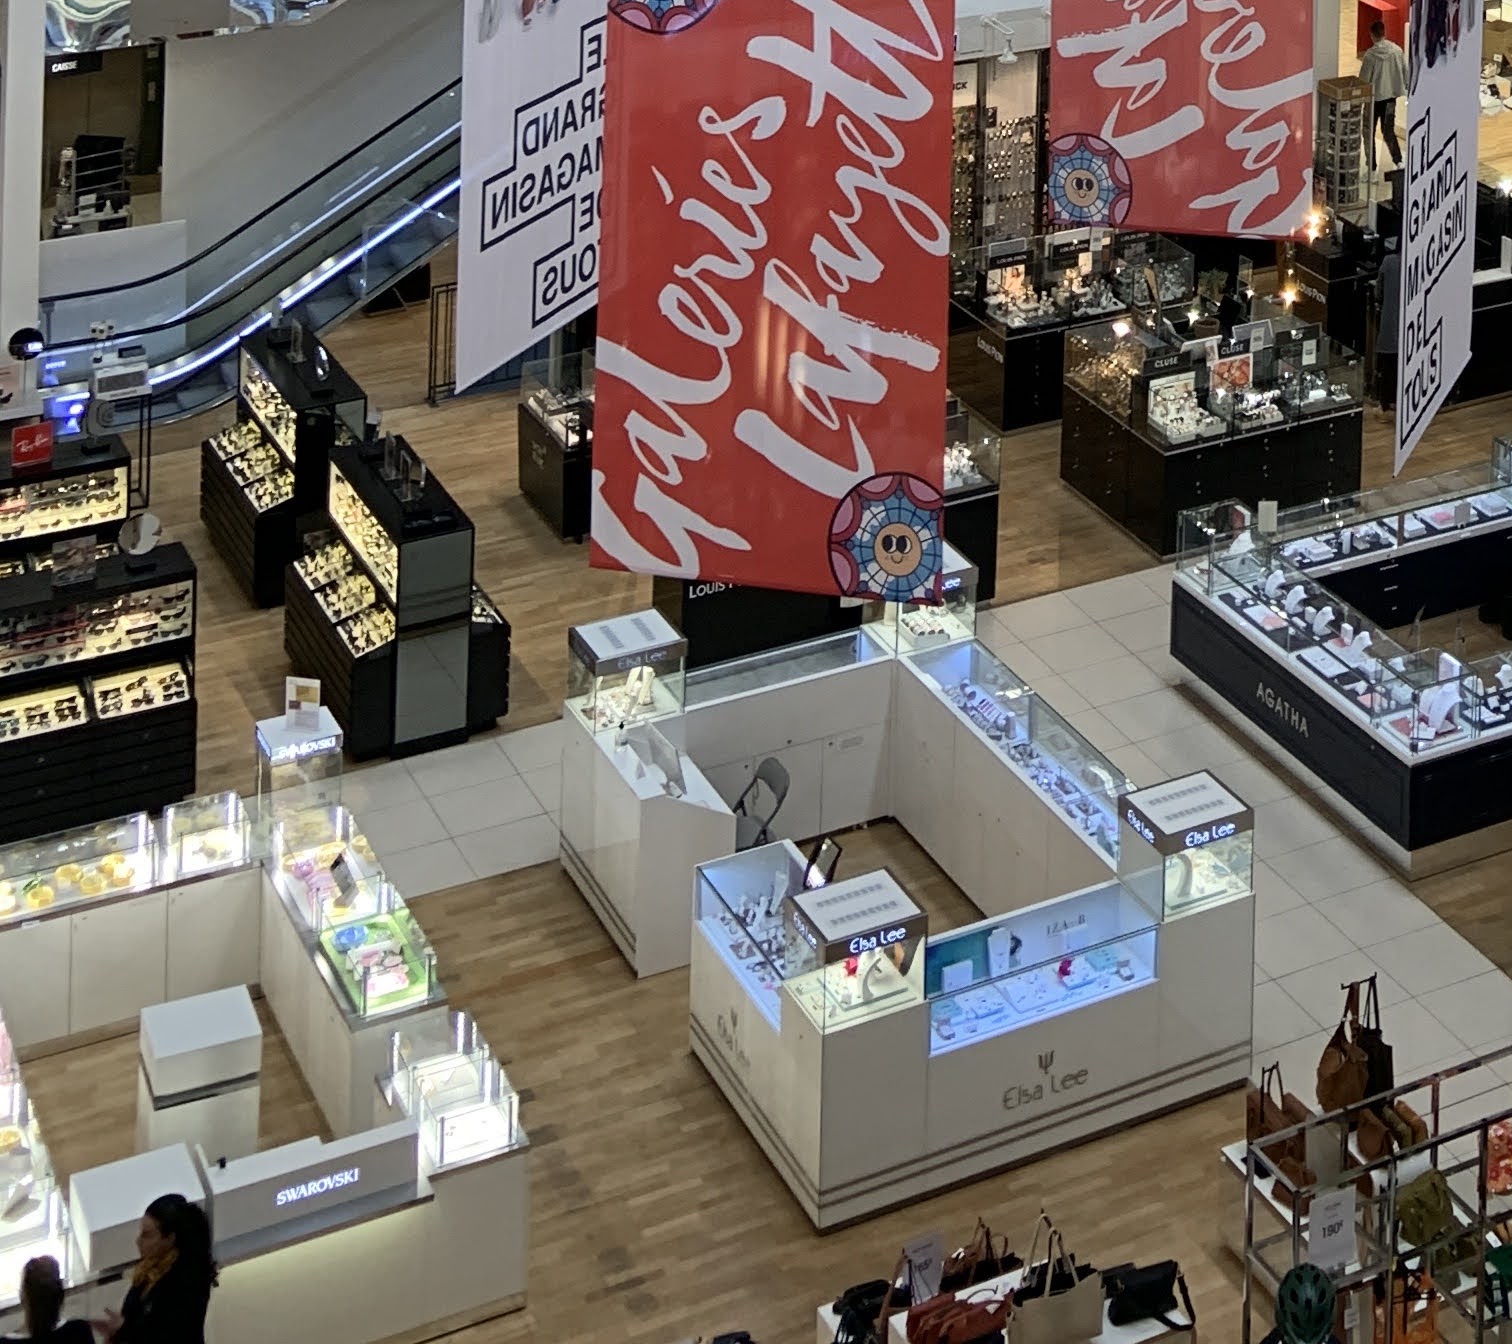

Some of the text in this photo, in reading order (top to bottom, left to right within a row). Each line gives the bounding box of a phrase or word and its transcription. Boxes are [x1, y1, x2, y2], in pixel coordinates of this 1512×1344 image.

[51, 60, 79, 74] CAISSE
[591, 96, 787, 580] Galeries
[1220, 343, 1245, 355] CLUSE
[1406, 307, 1423, 366] DE
[1154, 356, 1179, 369] CLUSE
[689, 582, 726, 599] LOUIS
[1255, 681, 1309, 738] AGATHA
[1185, 822, 1236, 847] Elsa Lee
[849, 925, 907, 953] Elsa Lee
[1002, 1068, 1089, 1111] Elsa Lee
[276, 1168, 360, 1206] SWAROVSKI
